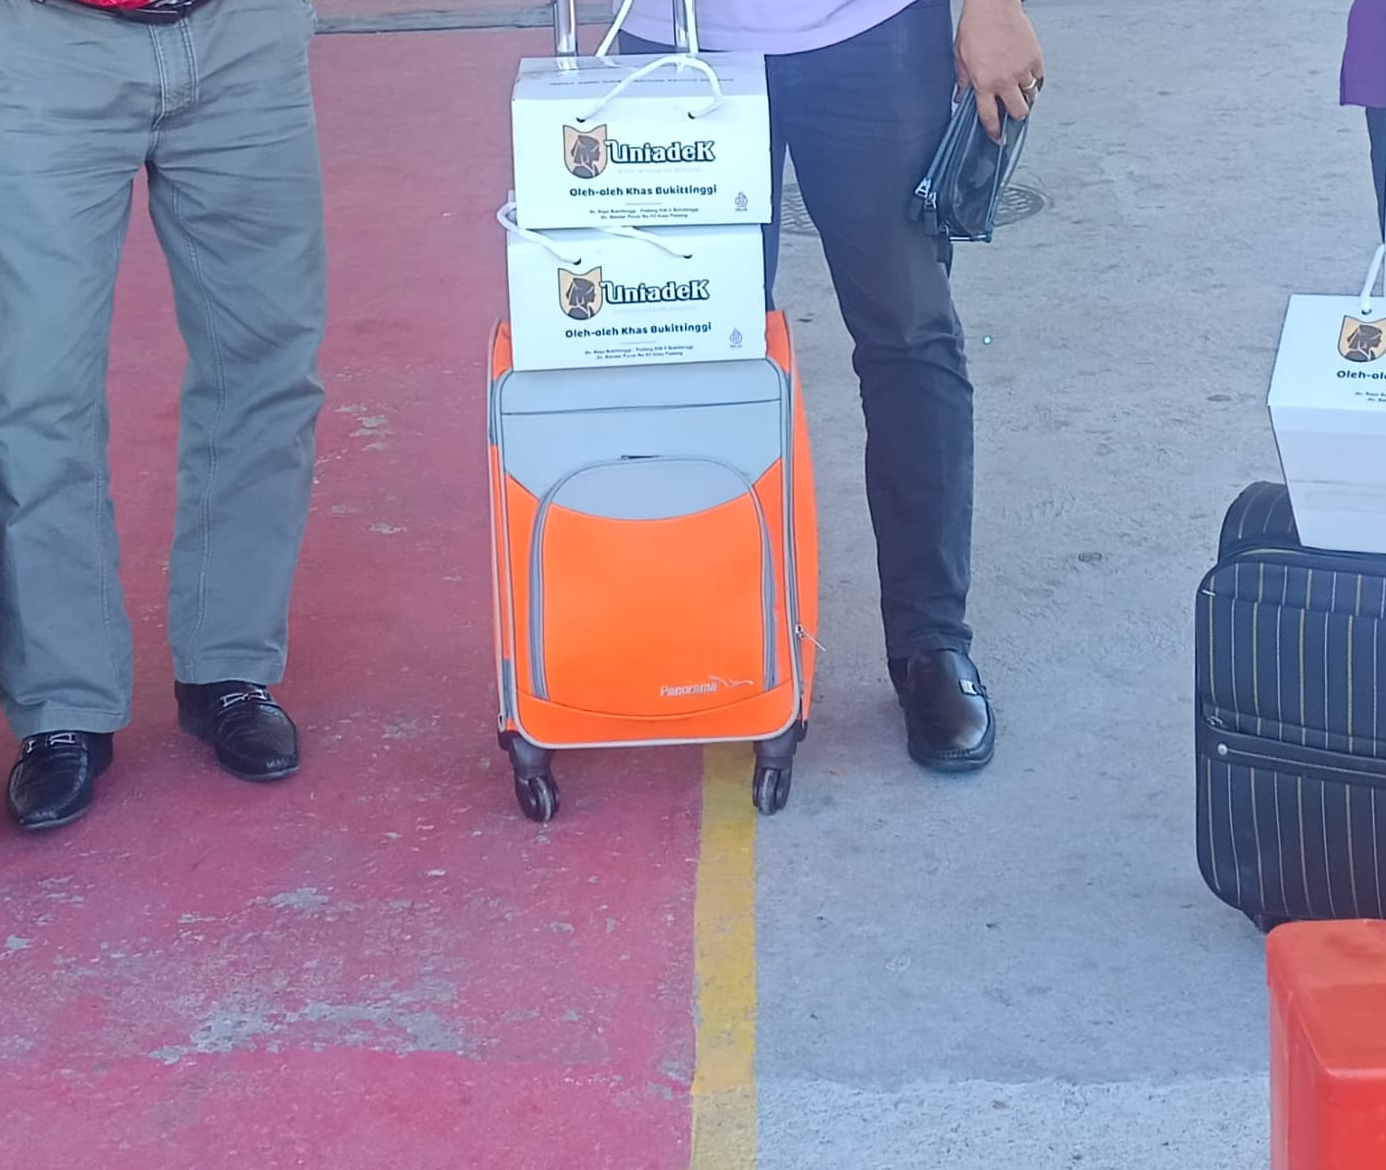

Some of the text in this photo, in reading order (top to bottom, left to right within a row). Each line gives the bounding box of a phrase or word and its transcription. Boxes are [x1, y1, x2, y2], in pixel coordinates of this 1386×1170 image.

[570, 184, 717, 197] Oleh-oleh Khas Bukittinggi
[565, 321, 712, 338] Oleh-oleh Khas Bukittinggi
